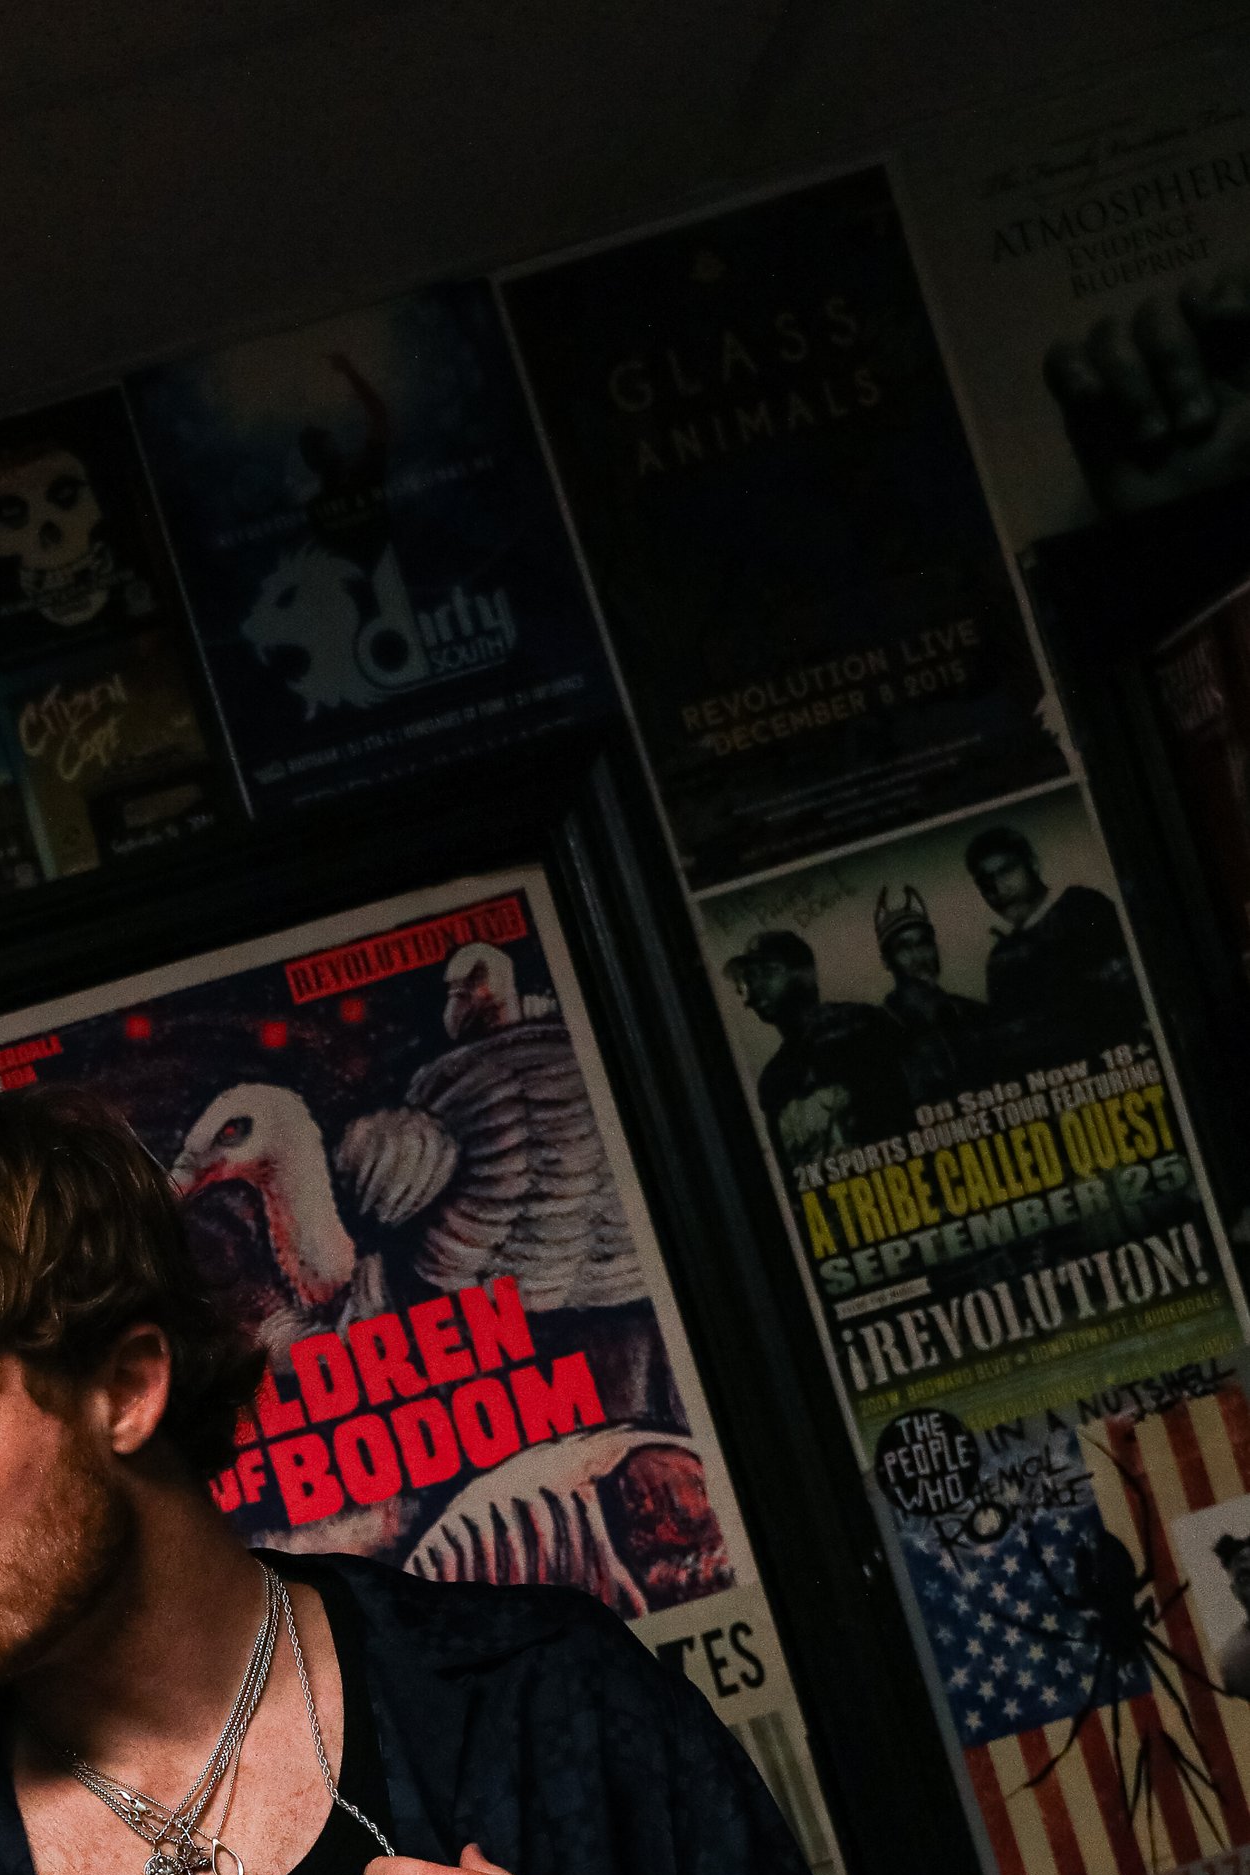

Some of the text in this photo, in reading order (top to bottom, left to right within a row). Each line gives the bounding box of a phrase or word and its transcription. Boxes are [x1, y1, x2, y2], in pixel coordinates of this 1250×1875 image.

[992, 146, 1250, 264] ATMOSPHER
[1071, 238, 1210, 298] BLUEPRINT
[607, 294, 861, 413] GLASS
[637, 368, 882, 477] ANIMALS
[429, 637, 508, 673] SOUTH
[681, 617, 981, 733] REVOLUTION LIVE
[711, 694, 869, 758] DECEMBER
[907, 659, 968, 702] 2015
[290, 896, 524, 1001] REVOLUTION LIVE
[792, 1056, 1163, 1194] 2K SPORTS BOUNCE TOUR FEATURING
[914, 1041, 1152, 1129] On Sale Now 18+
[800, 1083, 1177, 1261] A TRIBE CALLED QUEST
[817, 1150, 1191, 1297] SEPTEMBER 25
[234, 1274, 536, 1448] LDREN
[268, 1350, 607, 1528] BODOM
[881, 1433, 975, 1485] PEOPLE
[894, 1411, 946, 1446] THE
[894, 1475, 967, 1513] WHO
